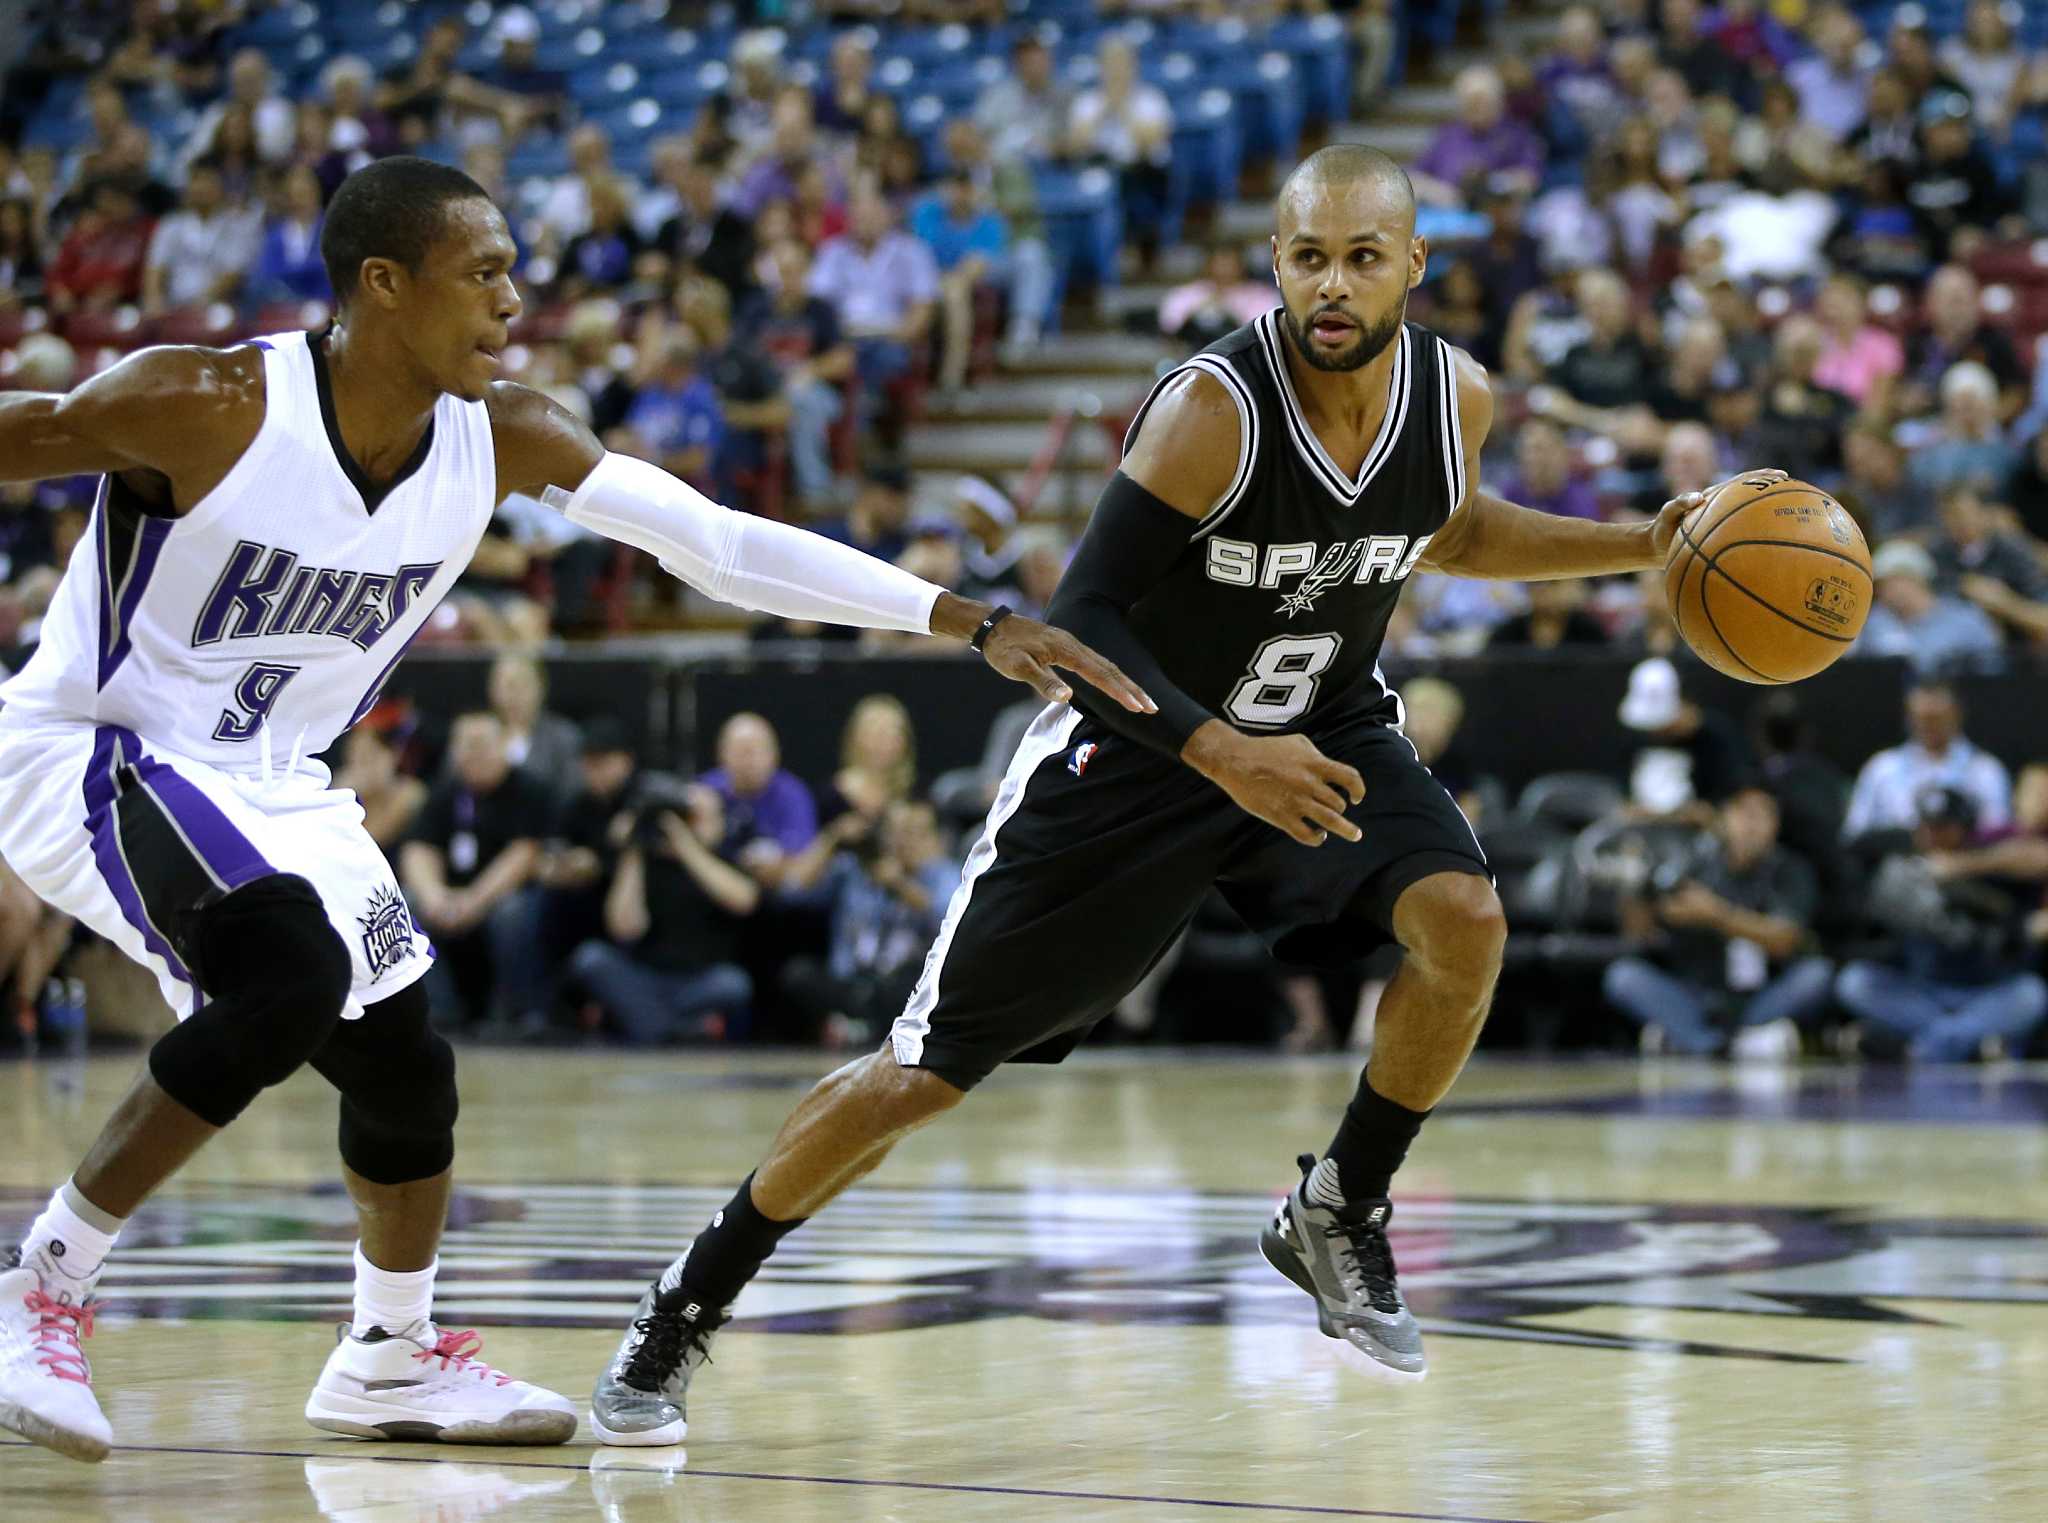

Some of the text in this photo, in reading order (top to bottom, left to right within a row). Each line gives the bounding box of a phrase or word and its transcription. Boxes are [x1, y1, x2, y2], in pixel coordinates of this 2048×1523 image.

[191, 539, 444, 652] KINGS
[211, 662, 301, 742] 9
[1222, 631, 1343, 730] 8
[366, 909, 410, 968] KINGS
